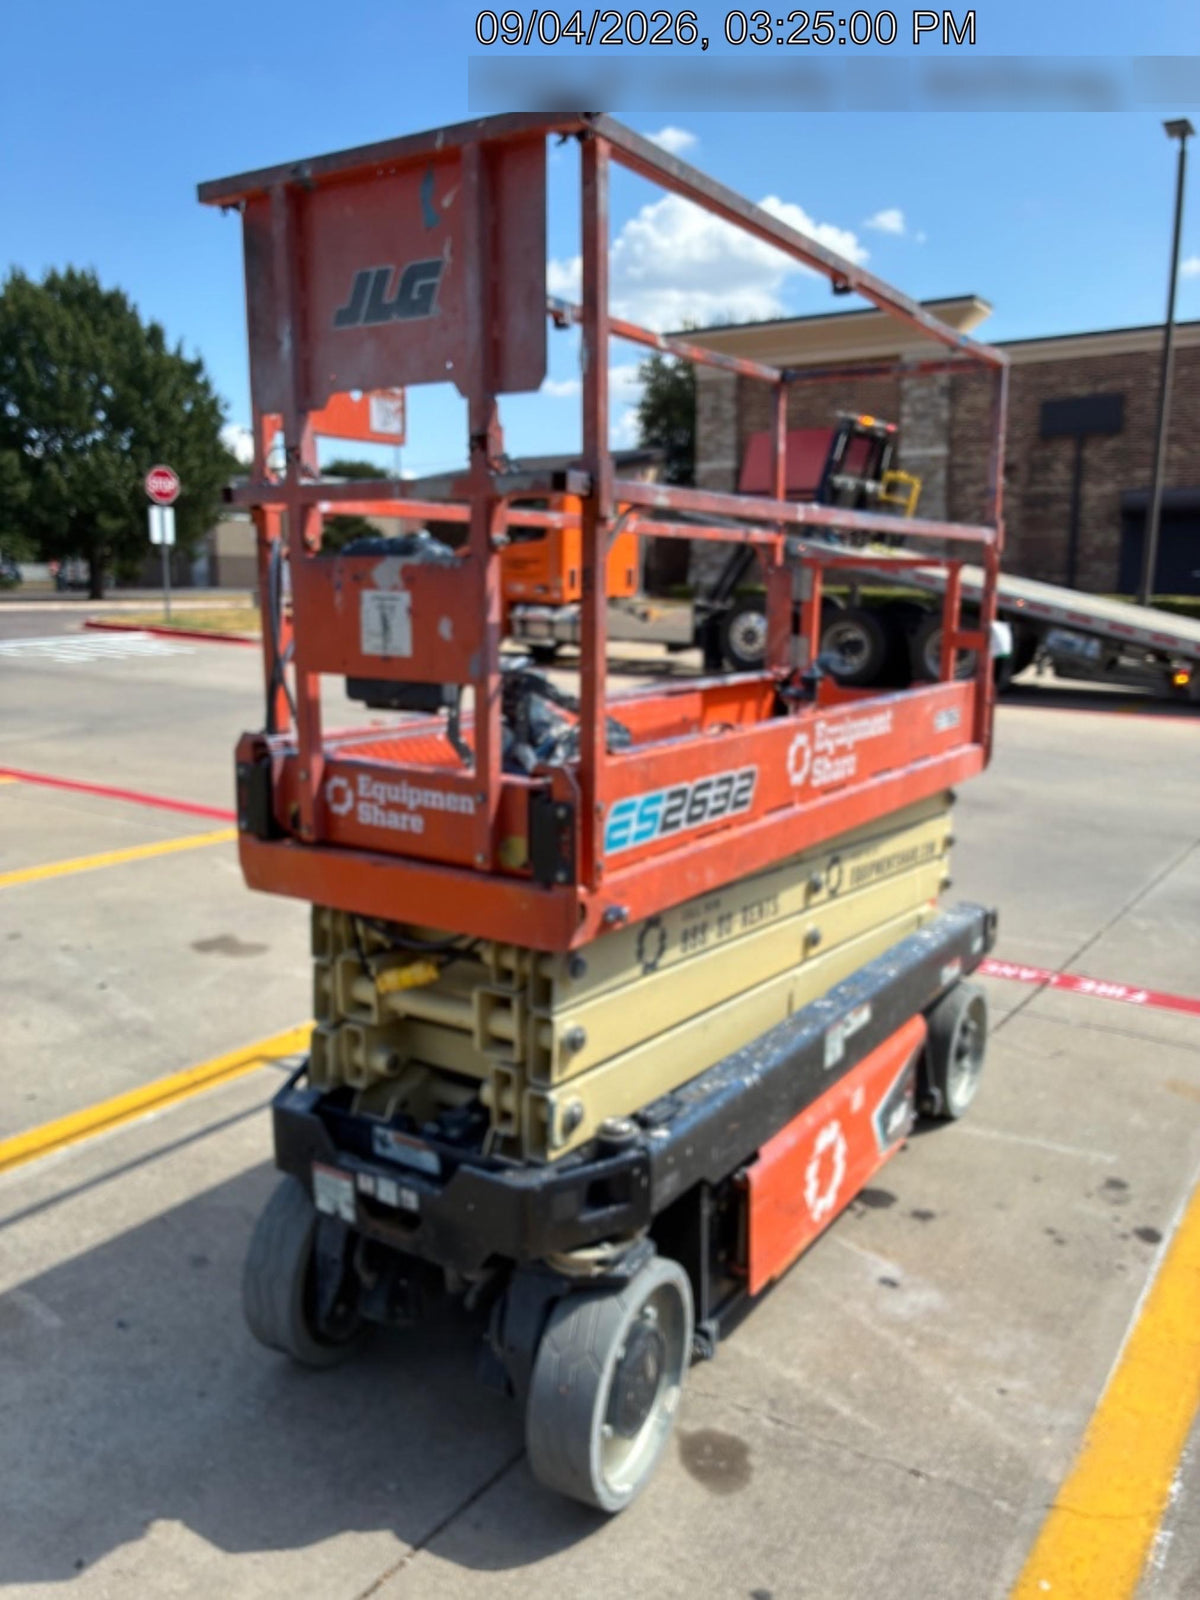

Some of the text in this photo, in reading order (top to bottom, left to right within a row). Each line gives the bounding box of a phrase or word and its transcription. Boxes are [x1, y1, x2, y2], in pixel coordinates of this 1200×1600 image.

[333, 258, 444, 328] JLG
[149, 476, 176, 491] STOP
[356, 774, 476, 815] Equipmen
[604, 767, 757, 854] ES2632
[356, 802, 424, 834] Share
